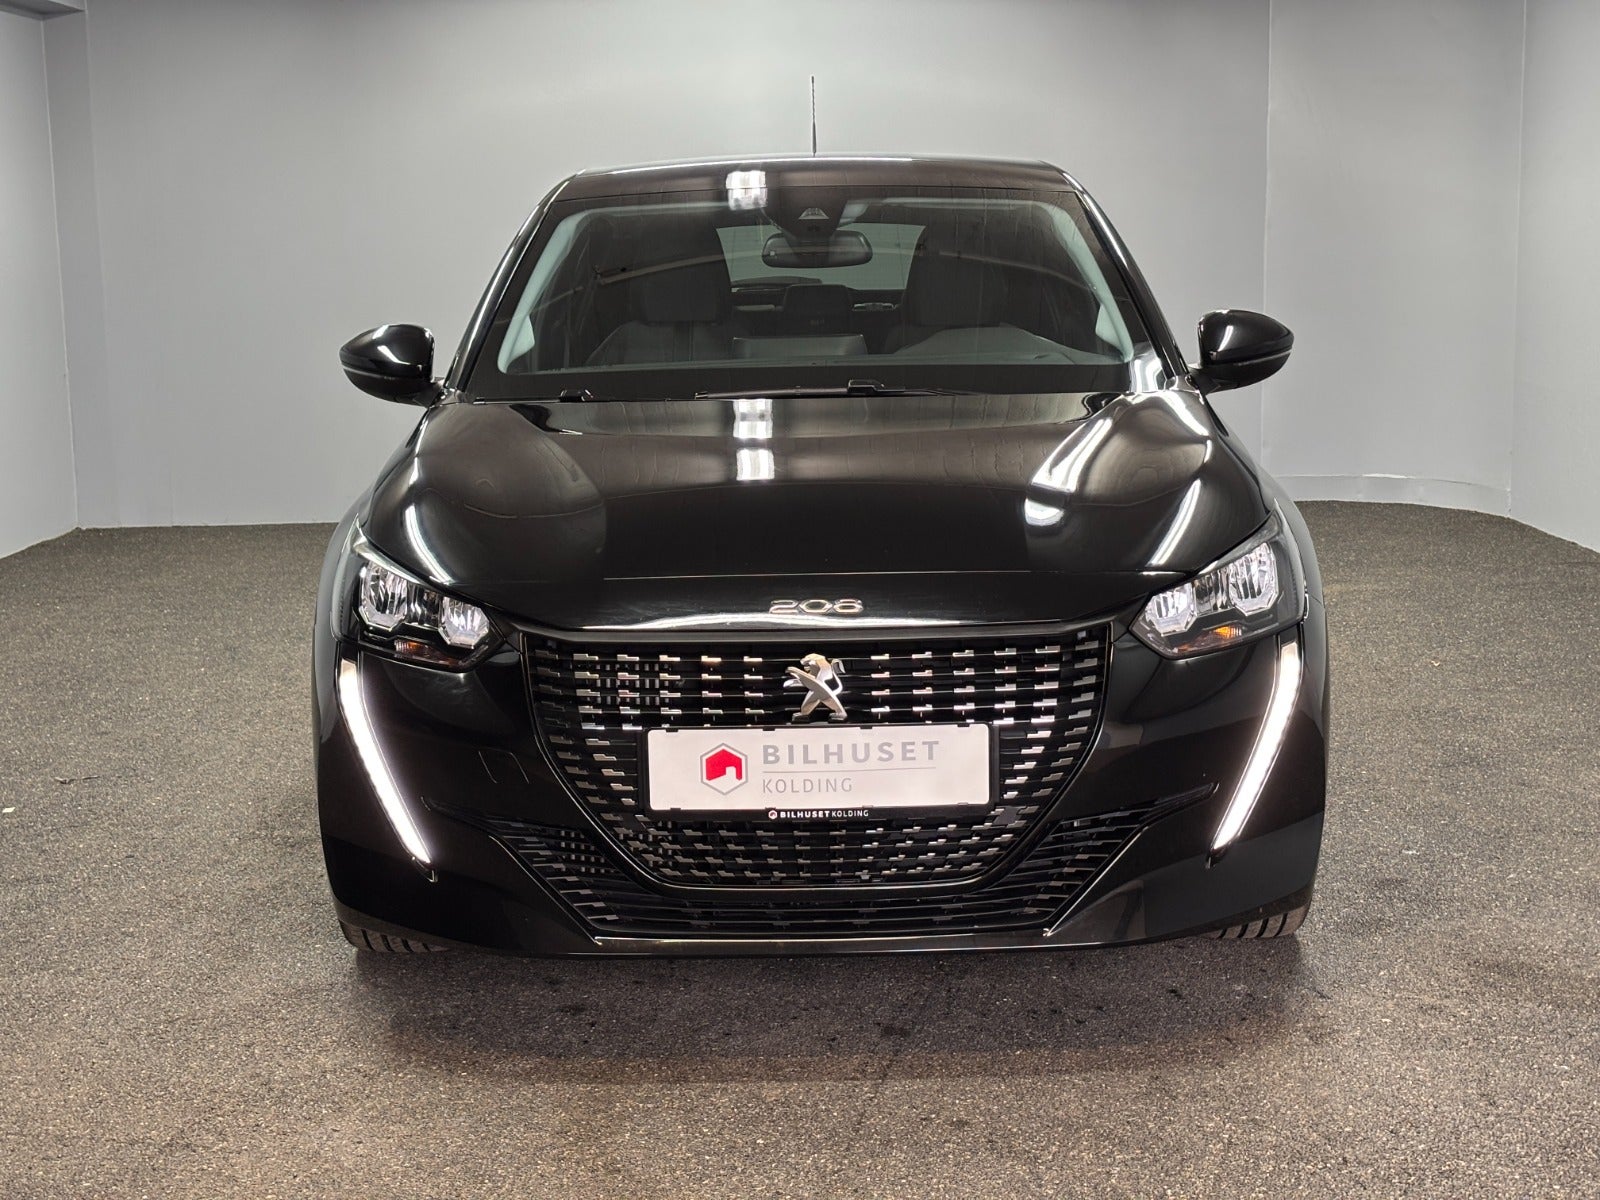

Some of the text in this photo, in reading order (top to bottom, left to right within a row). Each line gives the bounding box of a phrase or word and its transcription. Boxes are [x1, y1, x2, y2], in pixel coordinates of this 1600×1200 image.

[769, 599, 864, 614] 208
[762, 740, 940, 765] BILHUSET
[762, 777, 853, 794] KOLDING
